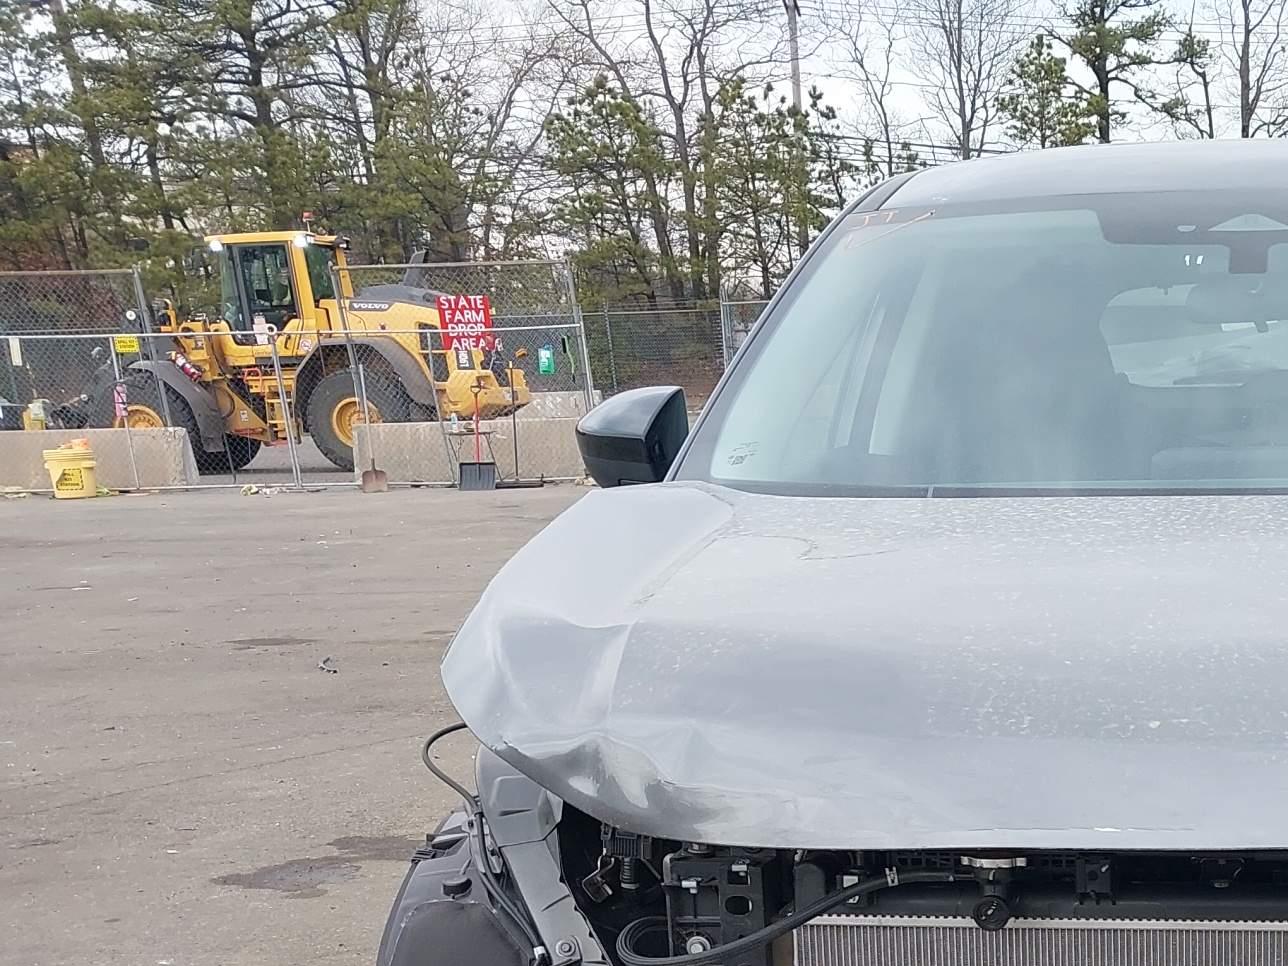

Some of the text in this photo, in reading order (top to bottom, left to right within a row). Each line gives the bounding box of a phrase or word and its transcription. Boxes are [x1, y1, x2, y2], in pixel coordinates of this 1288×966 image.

[440, 295, 485, 309] STATE
[444, 309, 486, 323] FARM
[447, 323, 486, 337] DROP
[450, 337, 489, 351] AREA
